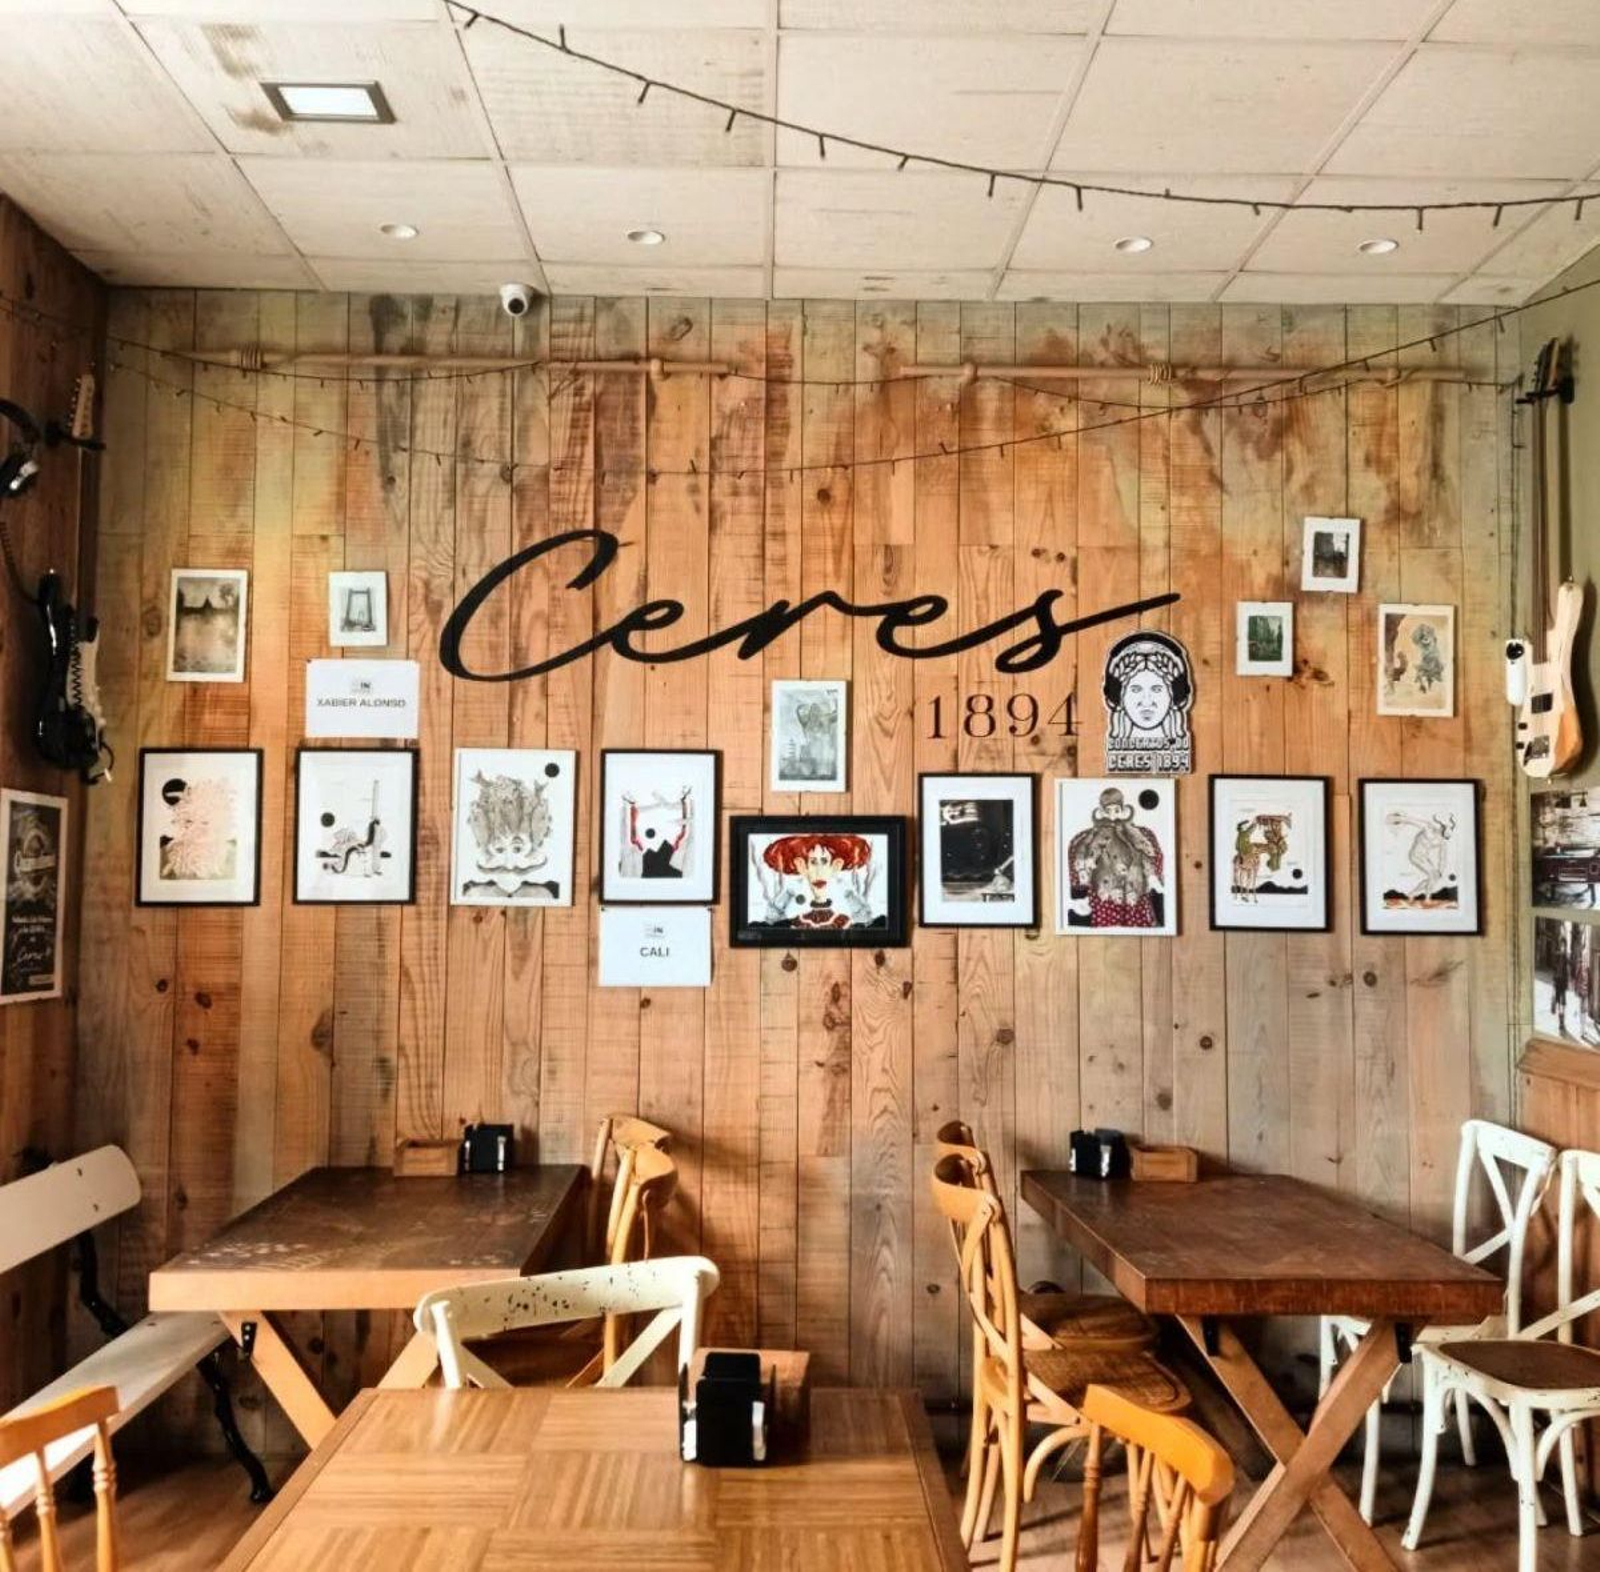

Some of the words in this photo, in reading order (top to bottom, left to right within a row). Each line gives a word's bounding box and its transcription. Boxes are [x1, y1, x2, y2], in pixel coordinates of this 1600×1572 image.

[440, 529, 1181, 681] Ceres
[317, 698, 356, 708] XABIER
[360, 698, 406, 709] ALONSO
[927, 693, 1079, 740] 1894
[1107, 753, 1152, 771] CERES
[1156, 753, 1190, 771] 1894
[639, 947, 670, 957] CALI
